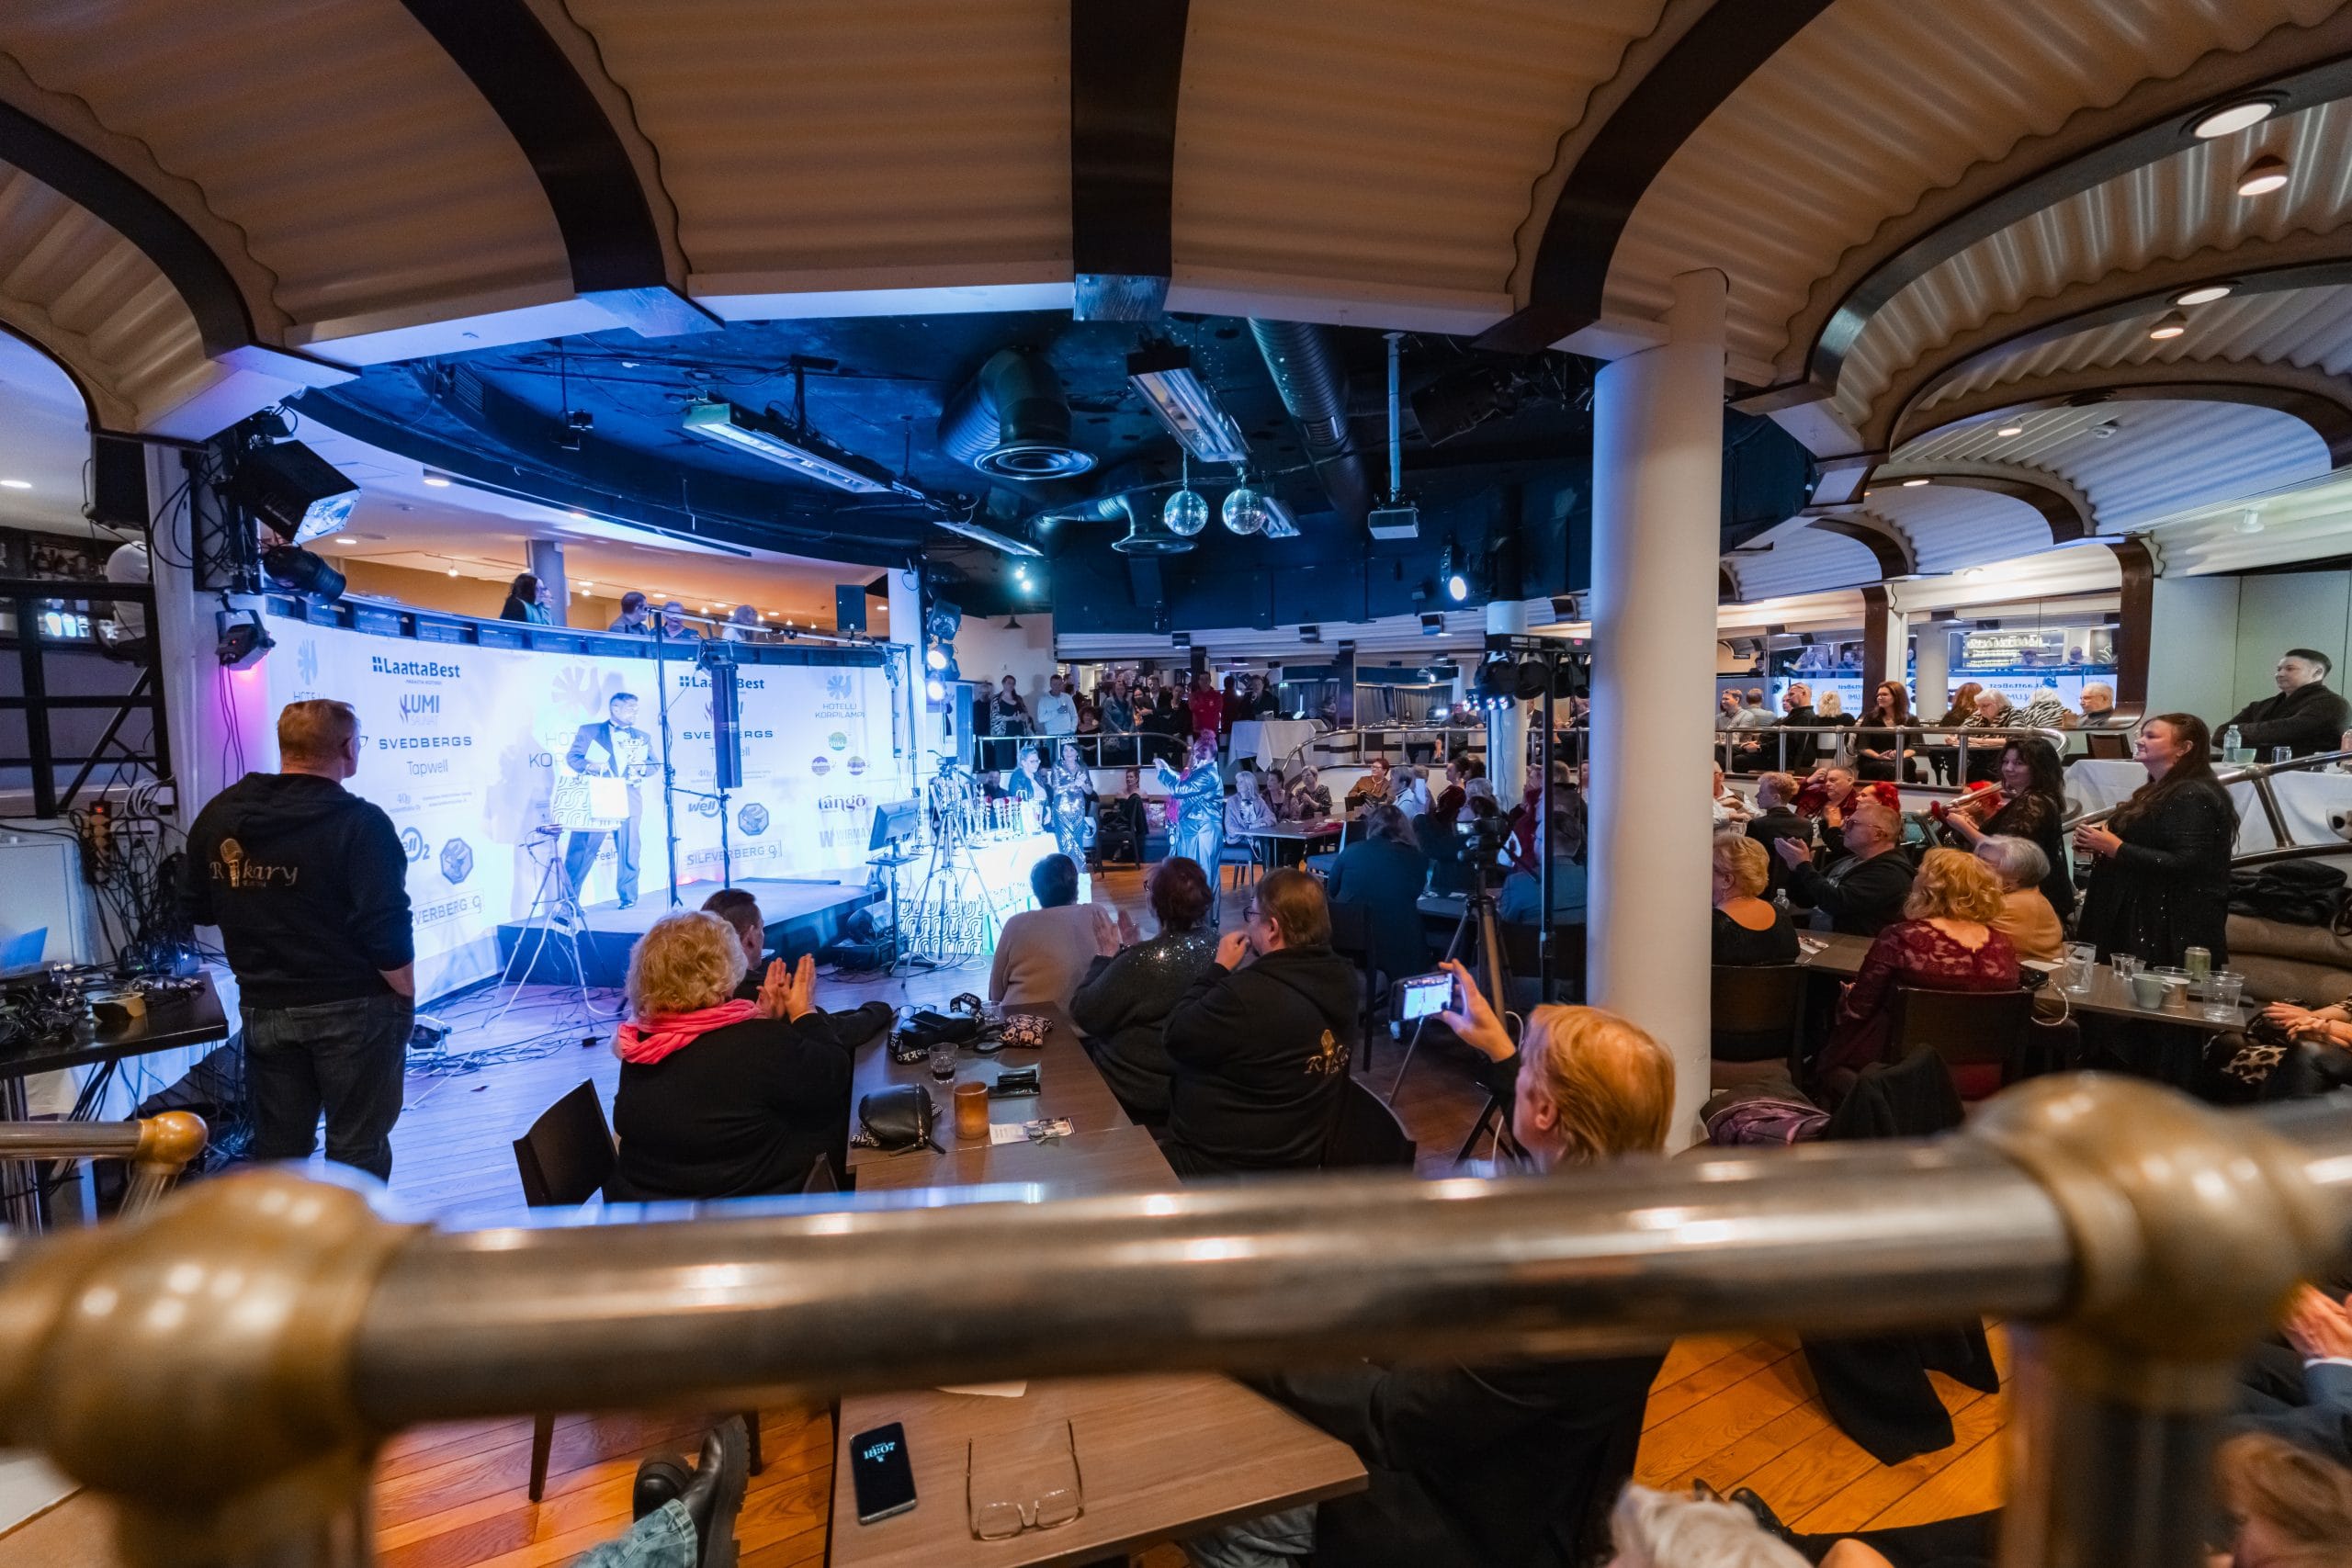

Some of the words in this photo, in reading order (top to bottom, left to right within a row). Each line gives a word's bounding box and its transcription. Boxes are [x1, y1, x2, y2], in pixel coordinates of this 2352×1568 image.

[383, 658, 461, 678] LaattaBest
[692, 676, 764, 689] LaBest
[400, 694, 440, 714] LUMI
[814, 711, 865, 719] KORPILAMPI
[379, 737, 472, 750] SVEDBERGS
[406, 759, 449, 777] Tapwell
[413, 898, 469, 925] VERBERG
[864, 1441, 896, 1460] 18:07
